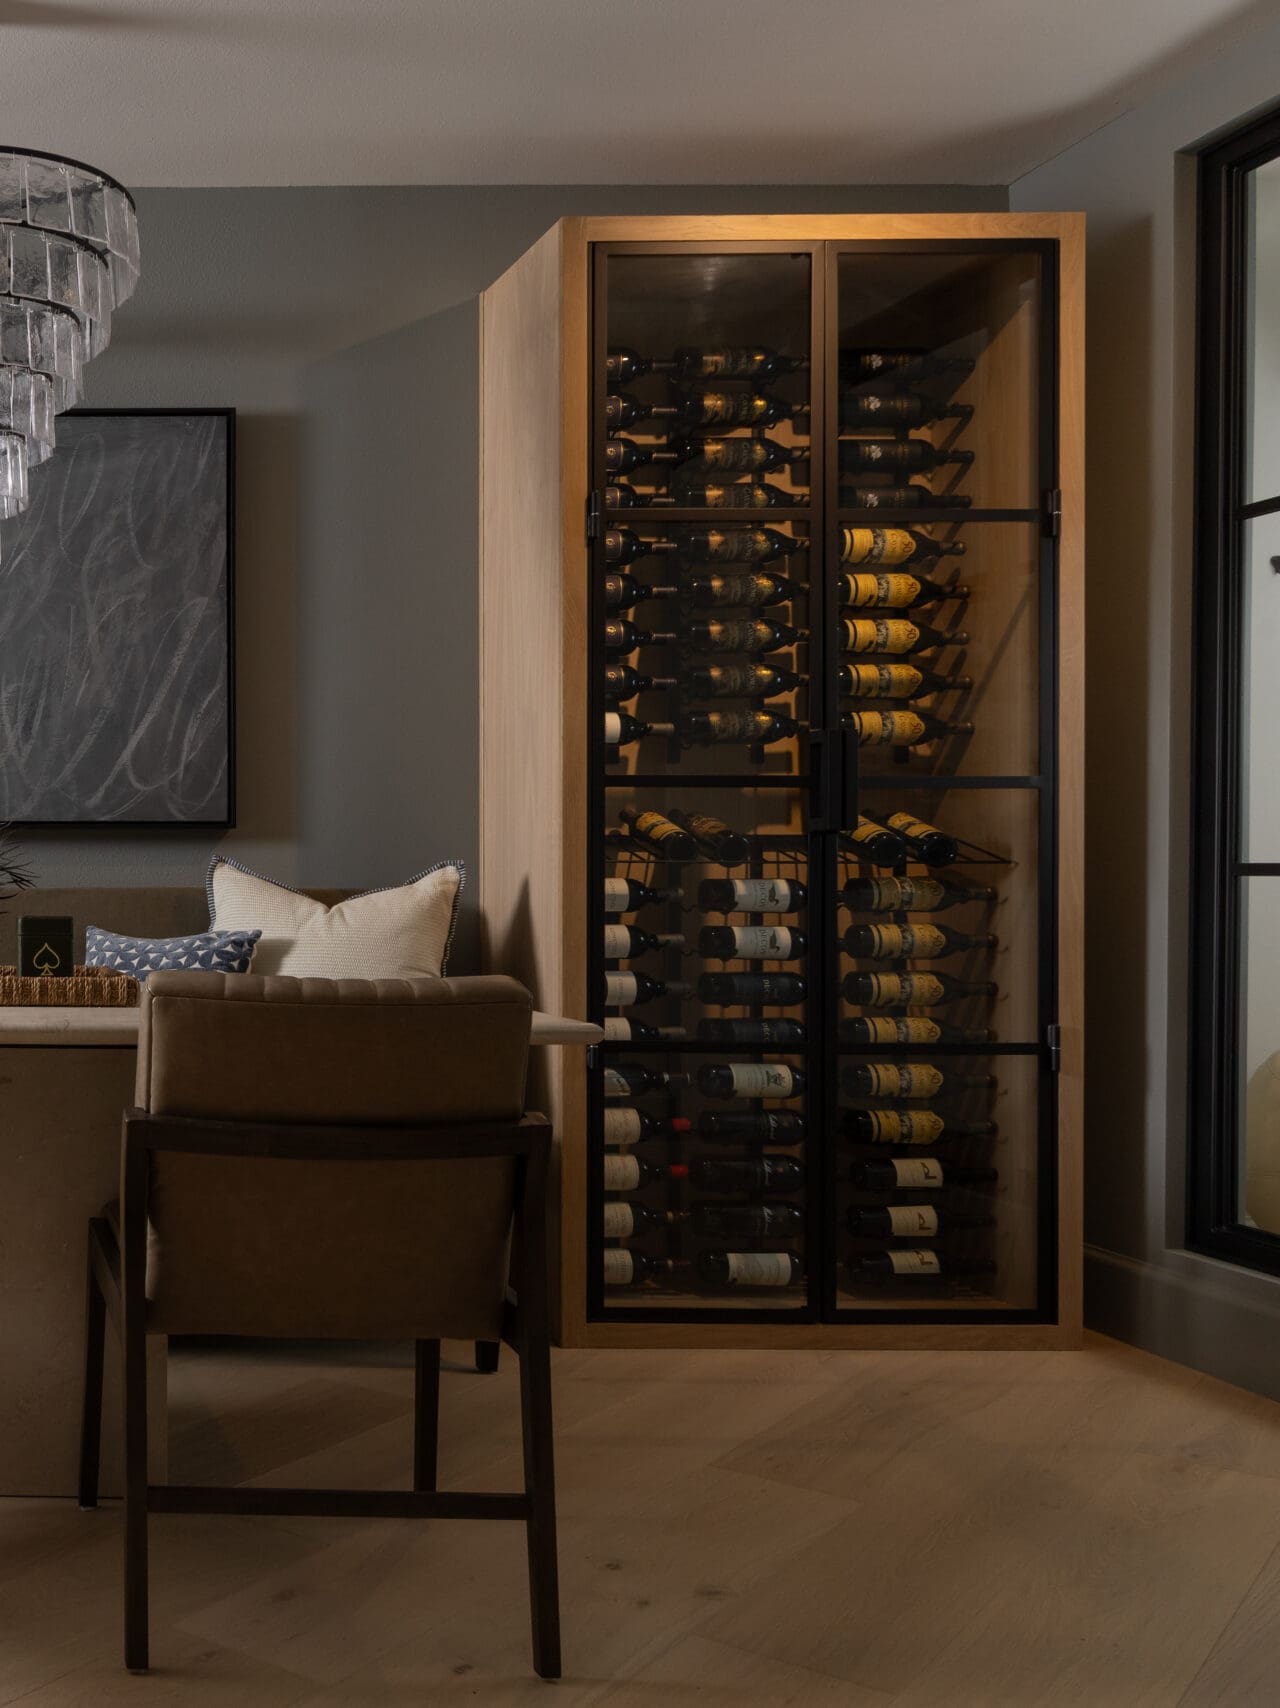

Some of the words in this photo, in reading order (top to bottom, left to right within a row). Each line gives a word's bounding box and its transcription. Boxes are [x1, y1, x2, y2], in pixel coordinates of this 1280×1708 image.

[902, 541, 913, 553] 50
[908, 582, 919, 593] 50
[905, 628, 917, 639] 50
[911, 722, 922, 734] 50
[927, 1026, 937, 1038] 50
